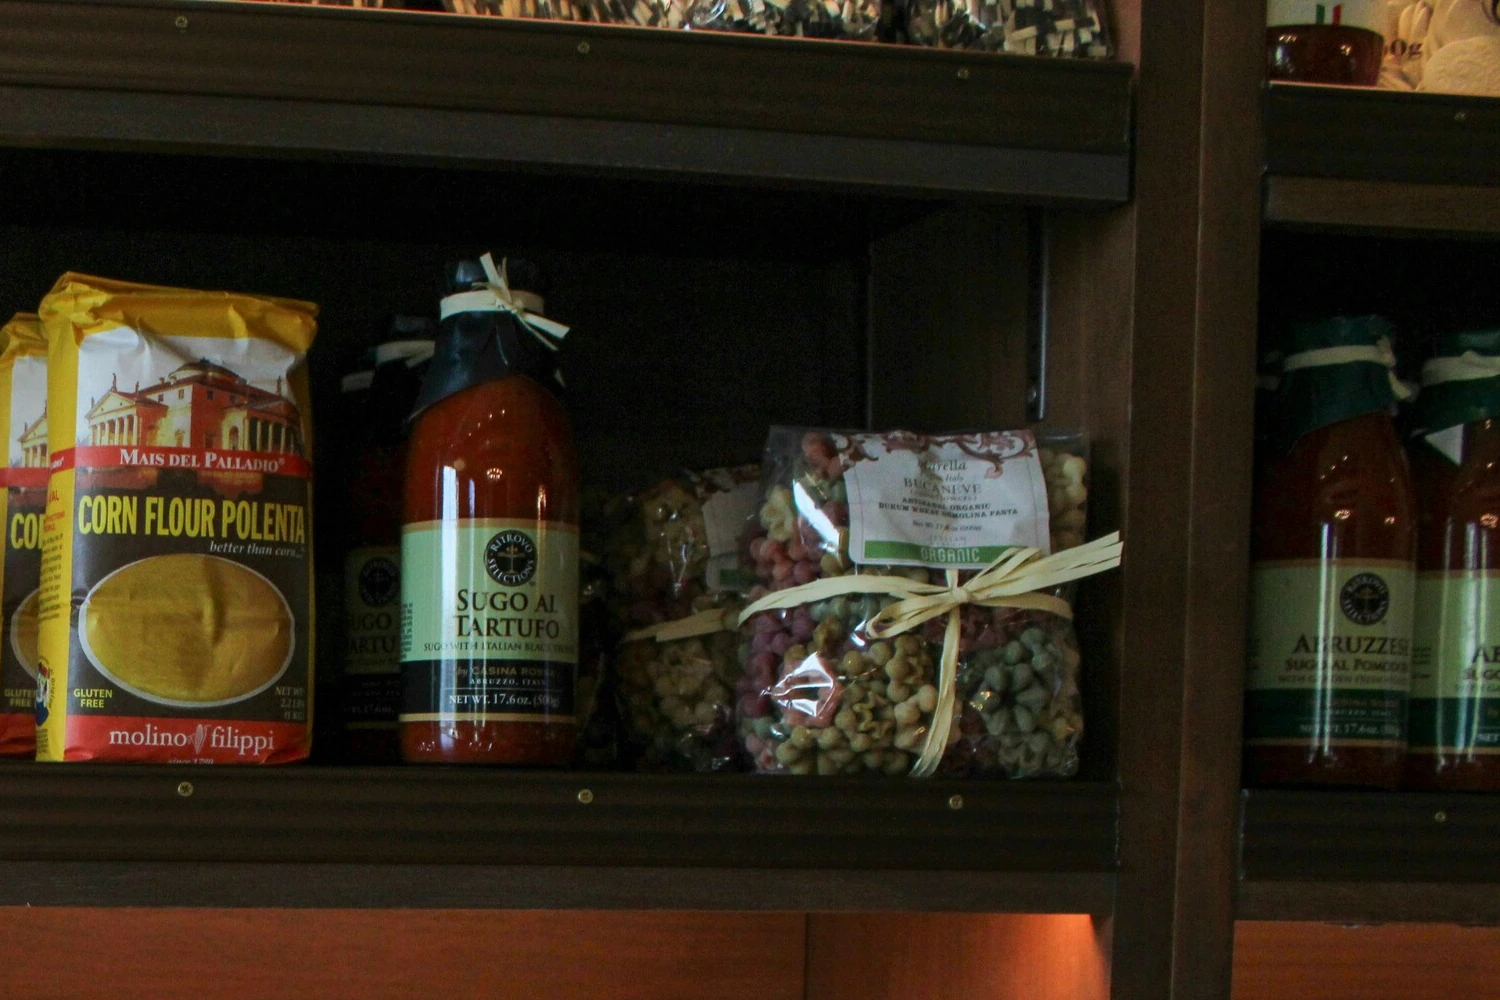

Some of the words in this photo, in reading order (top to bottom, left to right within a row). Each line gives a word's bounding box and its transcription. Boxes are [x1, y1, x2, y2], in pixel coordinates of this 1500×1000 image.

[120, 448, 165, 466] MAIS
[169, 454, 200, 467] DEL
[78, 495, 138, 535] CORN
[145, 497, 215, 537] FLOUR
[222, 500, 305, 544] POLENTA
[209, 540, 244, 553] better
[247, 544, 272, 555] than
[491, 533, 533, 552] RITROVO
[921, 548, 980, 562] ORGANIC
[488, 558, 535, 583] SELECTIONS
[457, 589, 528, 612] SUGO
[536, 594, 556, 613] AL
[453, 614, 559, 638] TARTUFO
[74, 688, 112, 699] GLUTEN
[450, 694, 469, 703] NET
[493, 693, 515, 704] 17.6
[80, 700, 104, 708] FREE
[108, 728, 187, 747] molino
[211, 728, 274, 756] filippi
